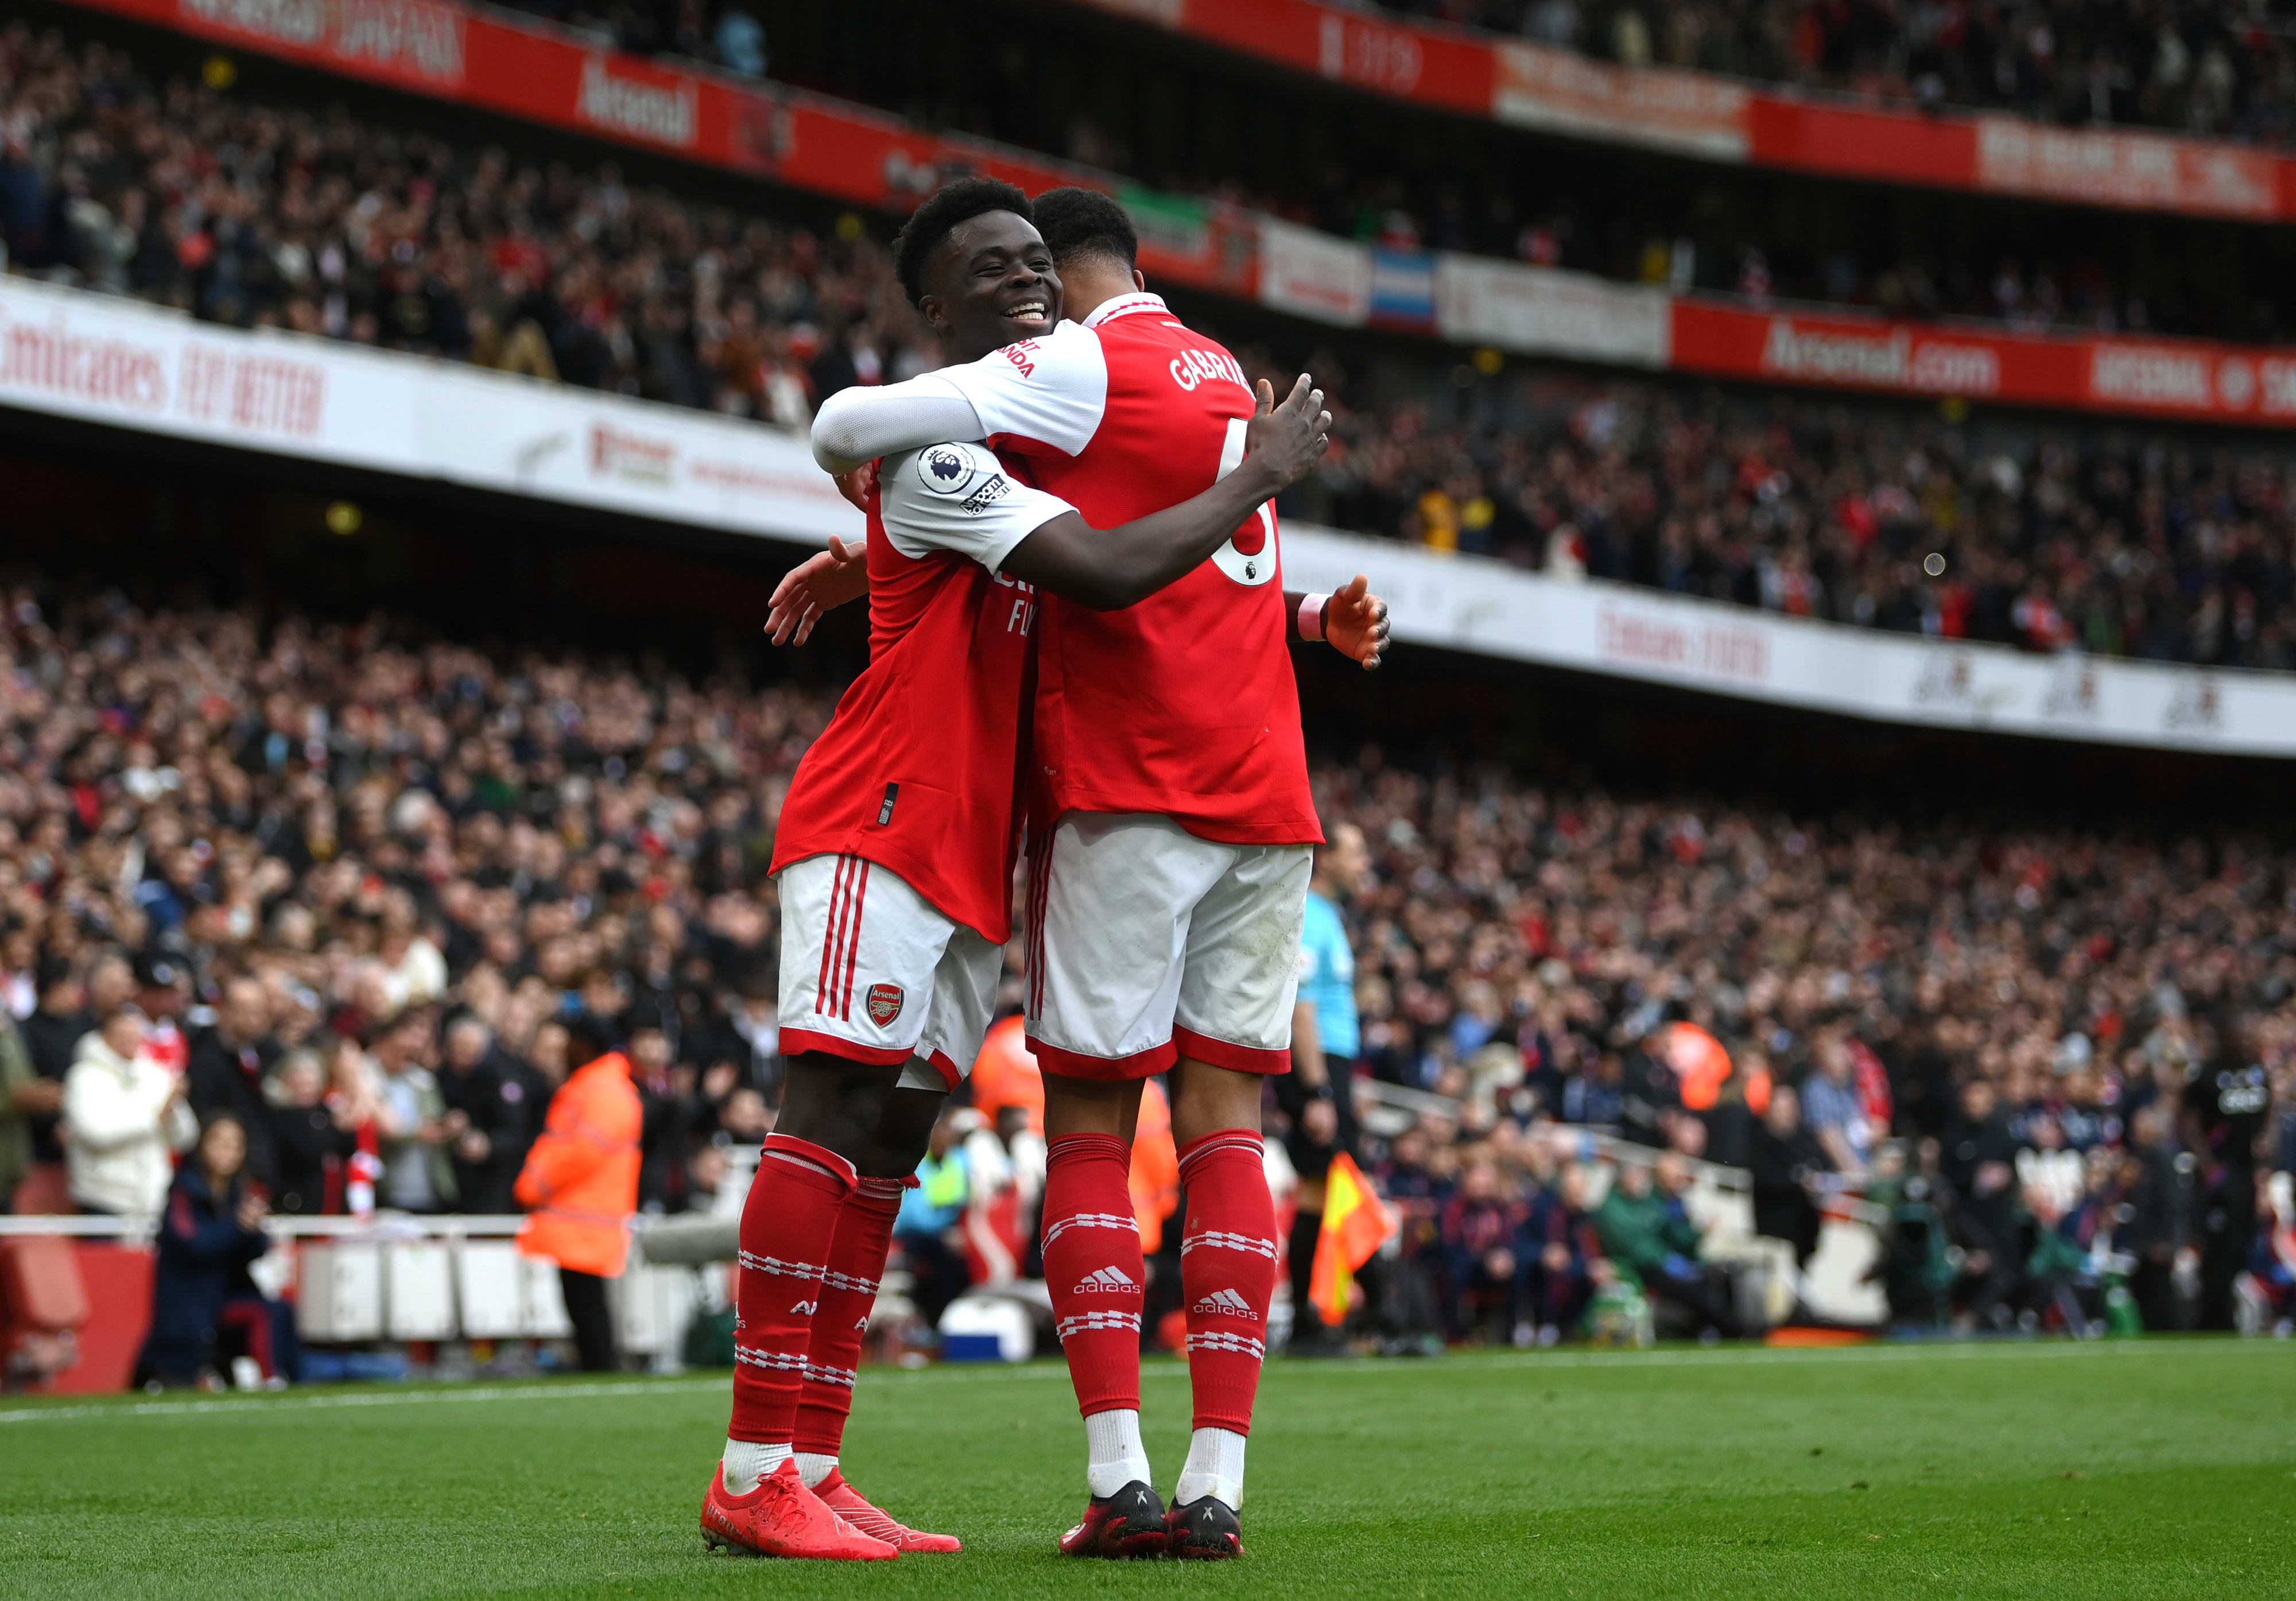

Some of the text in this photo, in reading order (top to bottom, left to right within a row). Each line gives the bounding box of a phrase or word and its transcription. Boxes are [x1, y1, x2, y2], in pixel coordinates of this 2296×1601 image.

[872, 990, 899, 1000] Arsenal
[1073, 1281, 1141, 1294] adidas
[1193, 1303, 1258, 1321] adidas
